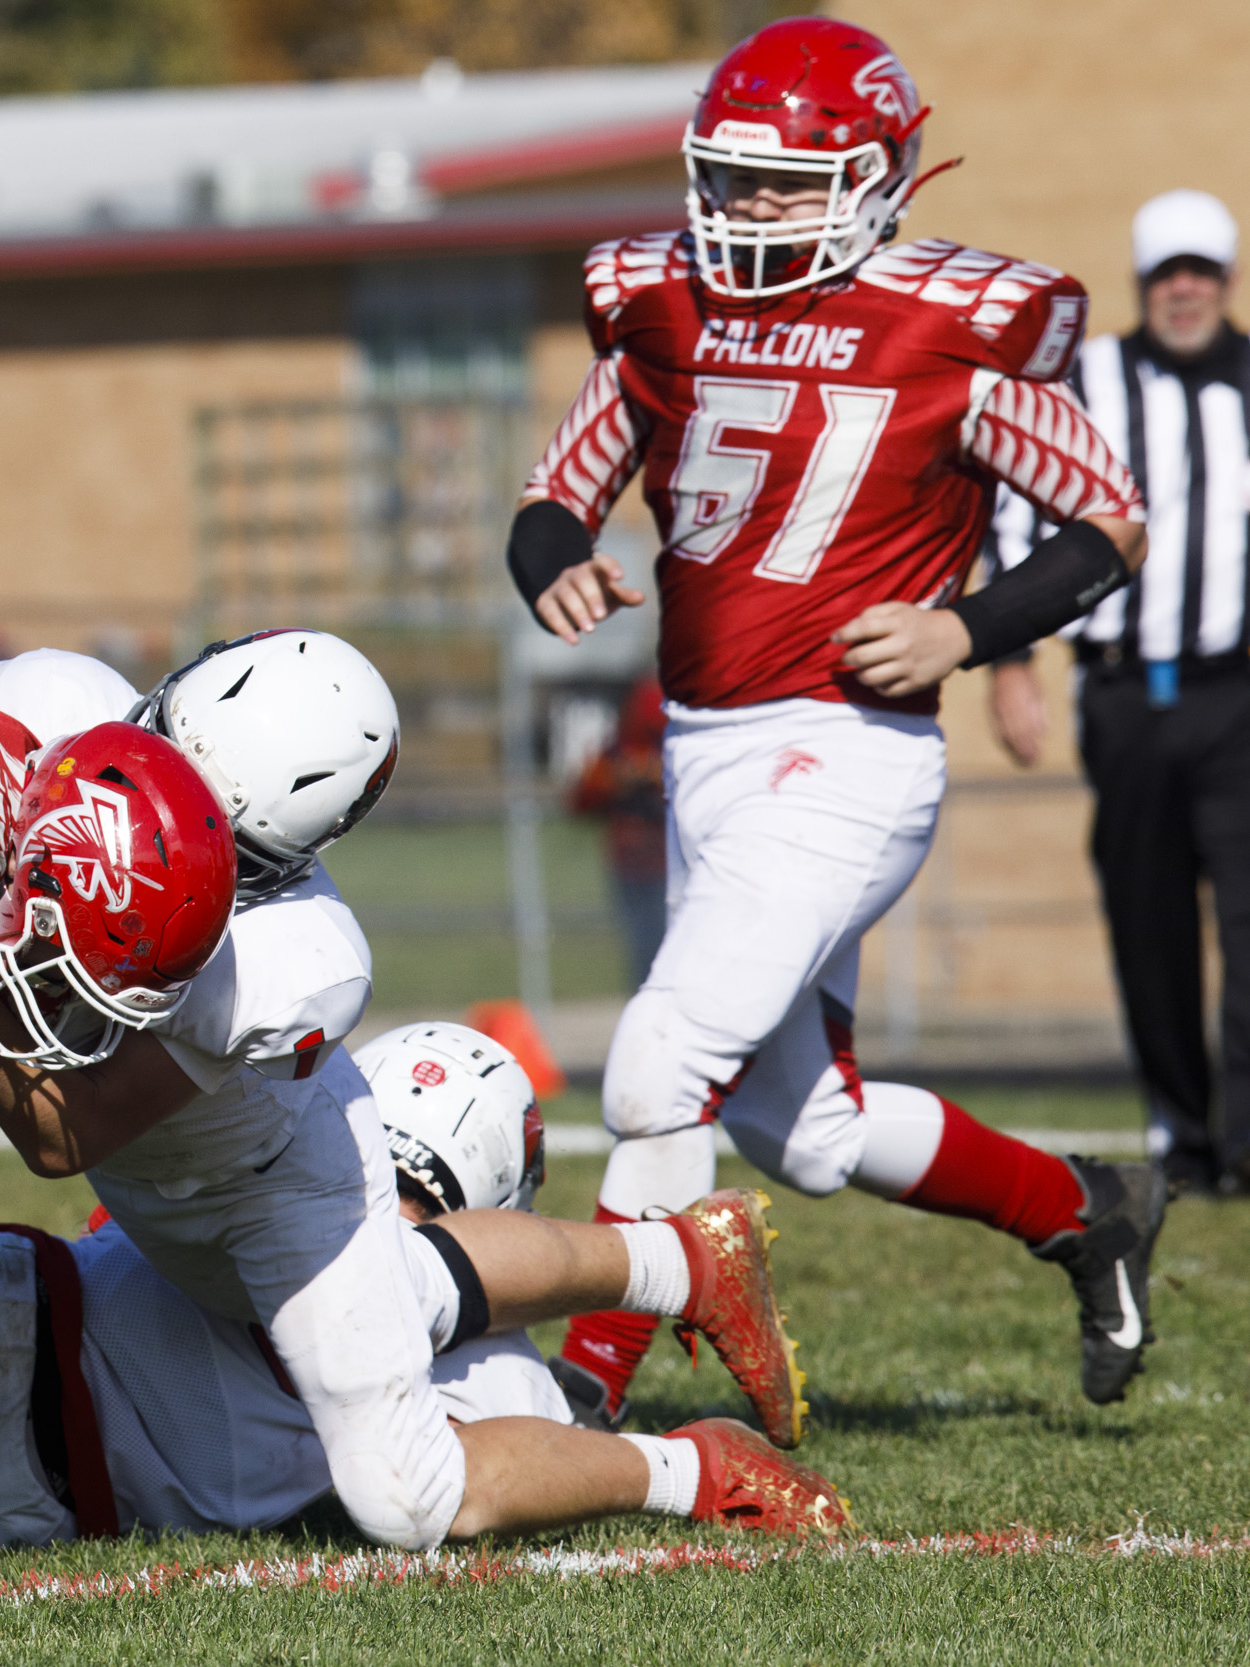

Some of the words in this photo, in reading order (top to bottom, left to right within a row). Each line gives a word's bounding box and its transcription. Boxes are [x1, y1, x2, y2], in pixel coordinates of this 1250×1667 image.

[693, 318, 865, 371] FALCONS
[1020, 295, 1088, 380] 6
[668, 375, 898, 585] 61
[384, 1127, 434, 1167] hutt
